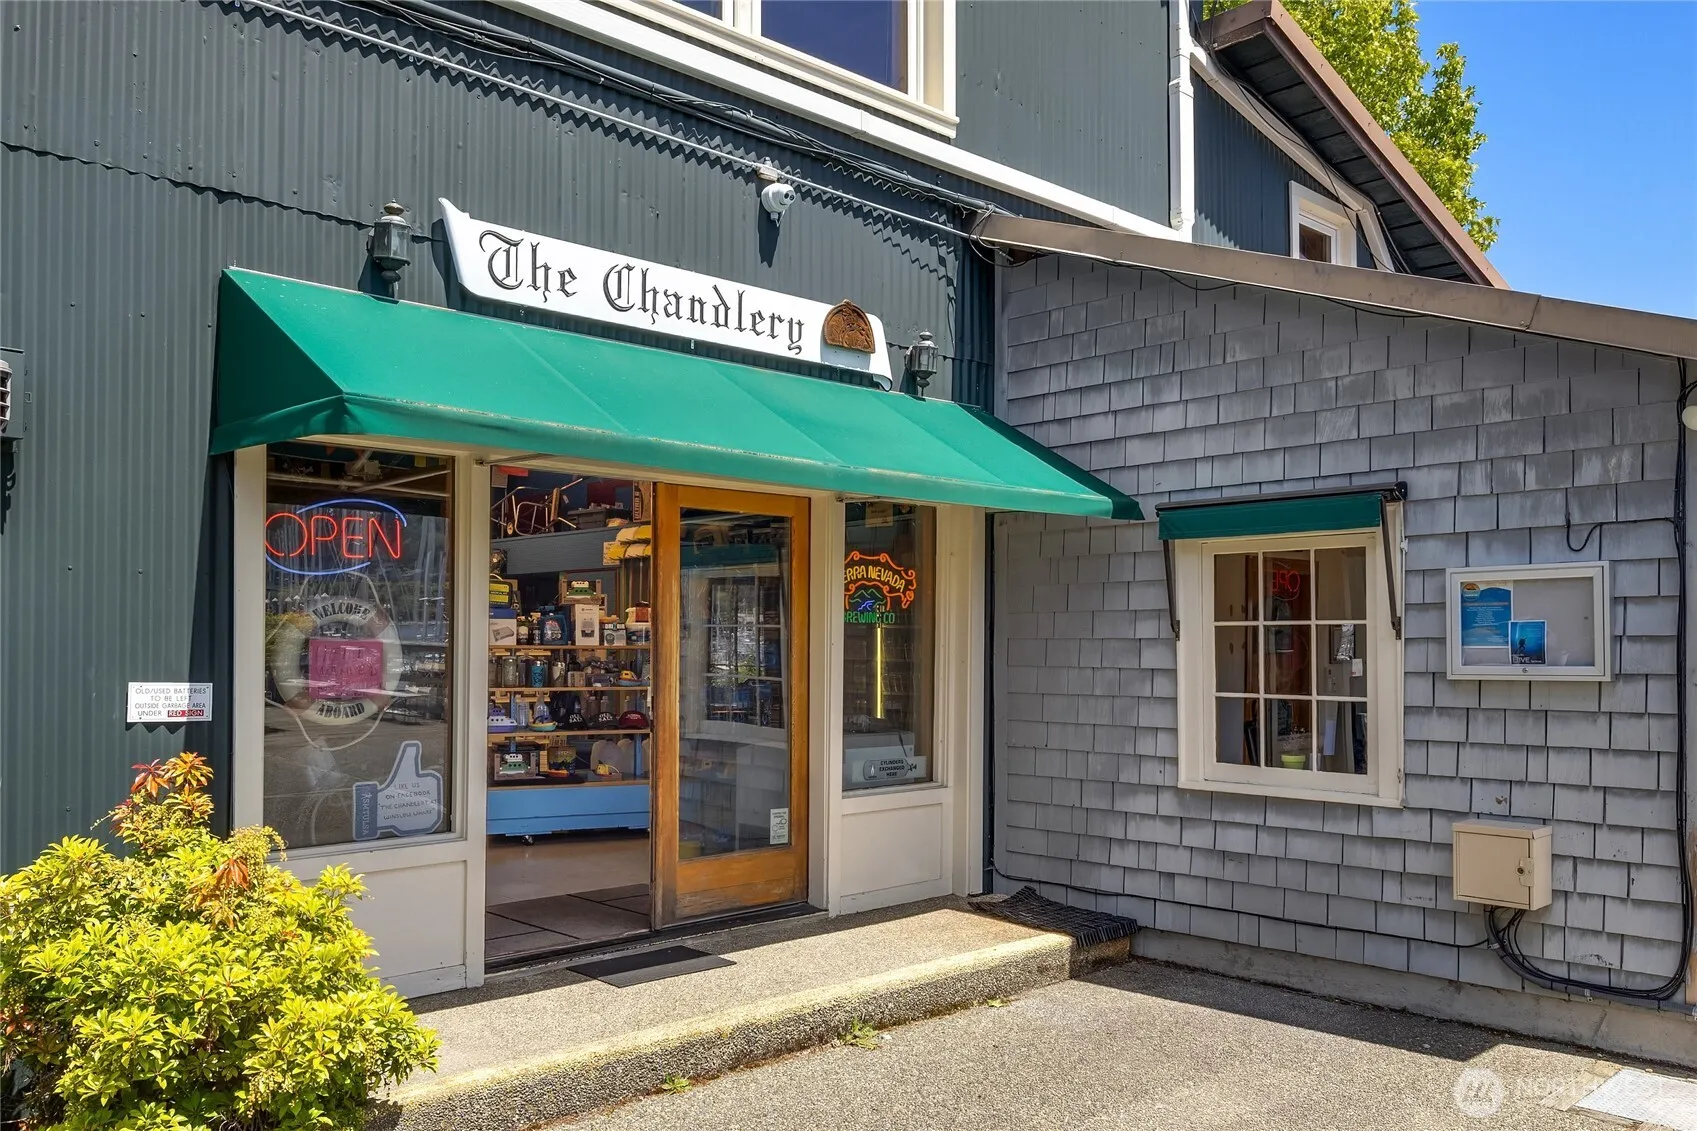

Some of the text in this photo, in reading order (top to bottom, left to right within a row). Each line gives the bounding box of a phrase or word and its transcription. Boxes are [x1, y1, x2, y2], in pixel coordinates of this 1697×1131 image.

[478, 229, 806, 356] The Chandlery
[264, 511, 402, 559] OPEN
[844, 564, 906, 593] RRA NEVADA
[312, 601, 371, 621] WELCOME
[883, 612, 896, 624] CO
[135, 687, 207, 695] OLD/USED BATTERIES
[168, 709, 183, 717] RED
[184, 709, 204, 717] SIGN
[316, 702, 366, 719] ABOARD
[880, 758, 904, 766] CYLINDERS
[393, 782, 408, 790] LIKE
[397, 790, 431, 799] FACEBOOK
